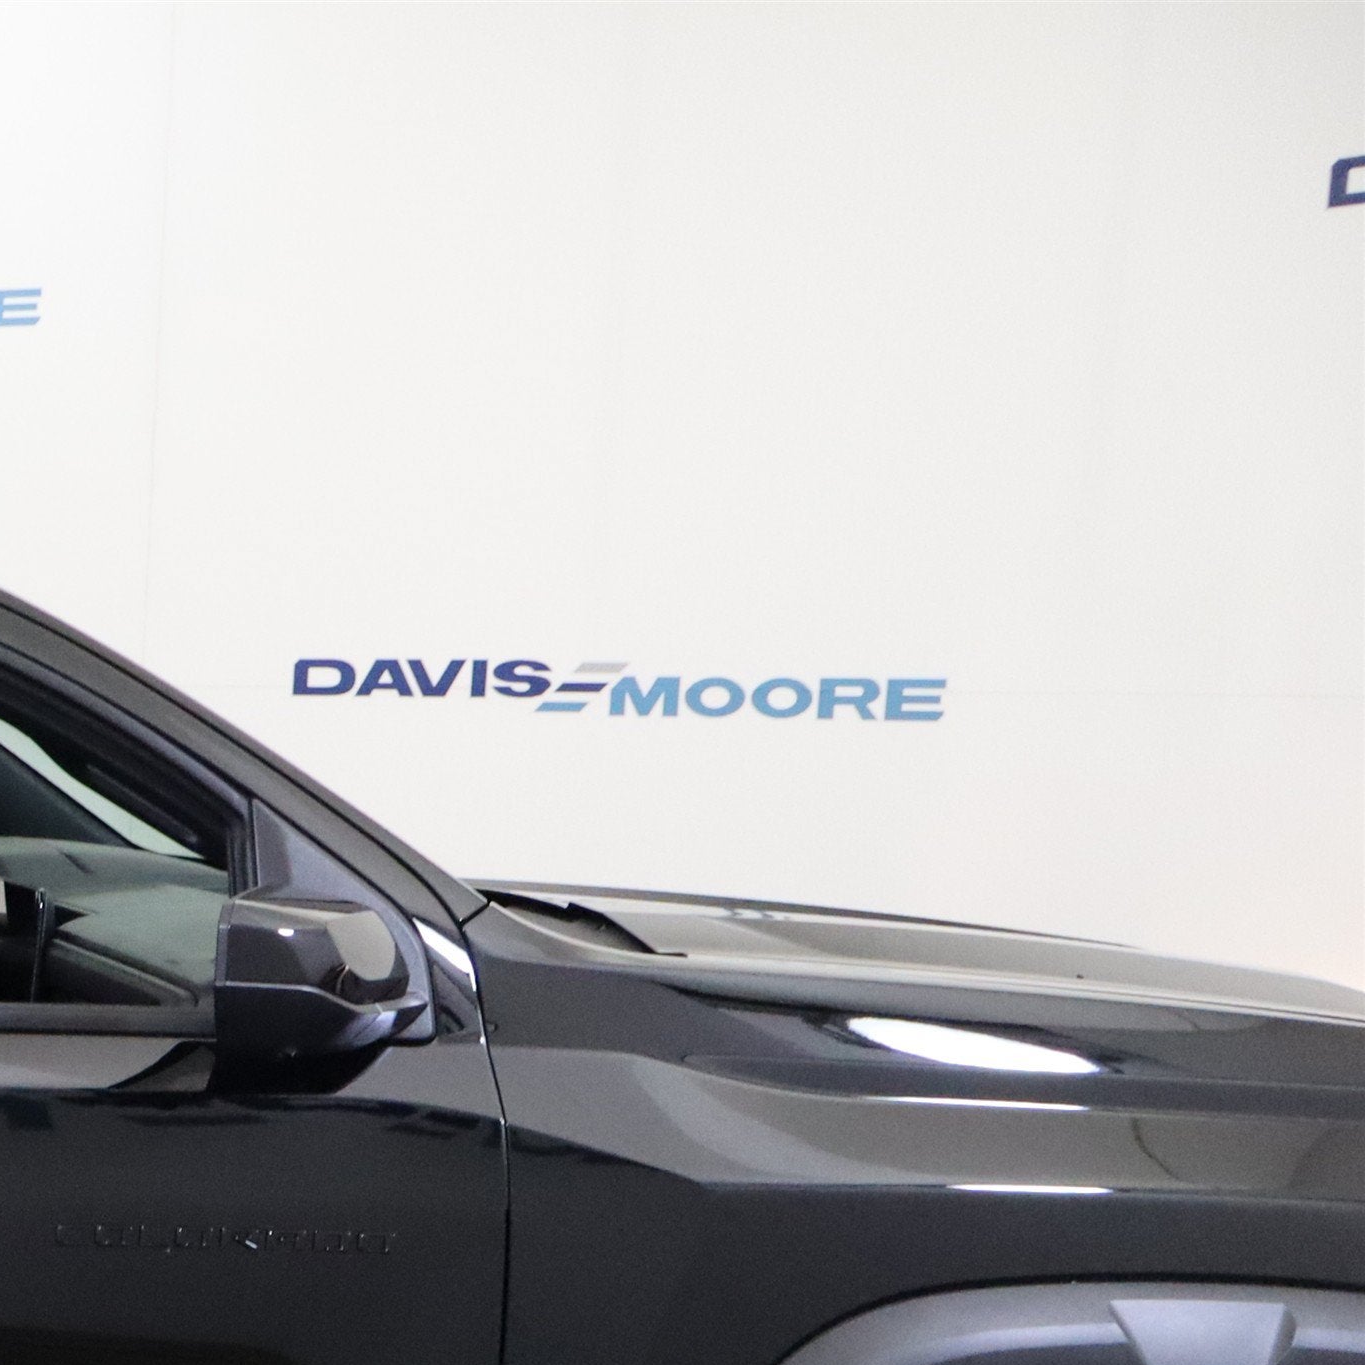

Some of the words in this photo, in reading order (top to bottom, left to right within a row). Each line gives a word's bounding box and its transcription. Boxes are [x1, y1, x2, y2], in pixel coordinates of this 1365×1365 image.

[292, 658, 552, 698] DAVIS
[609, 676, 947, 722] MOORE
[55, 1223, 397, 1254] COLORADO
